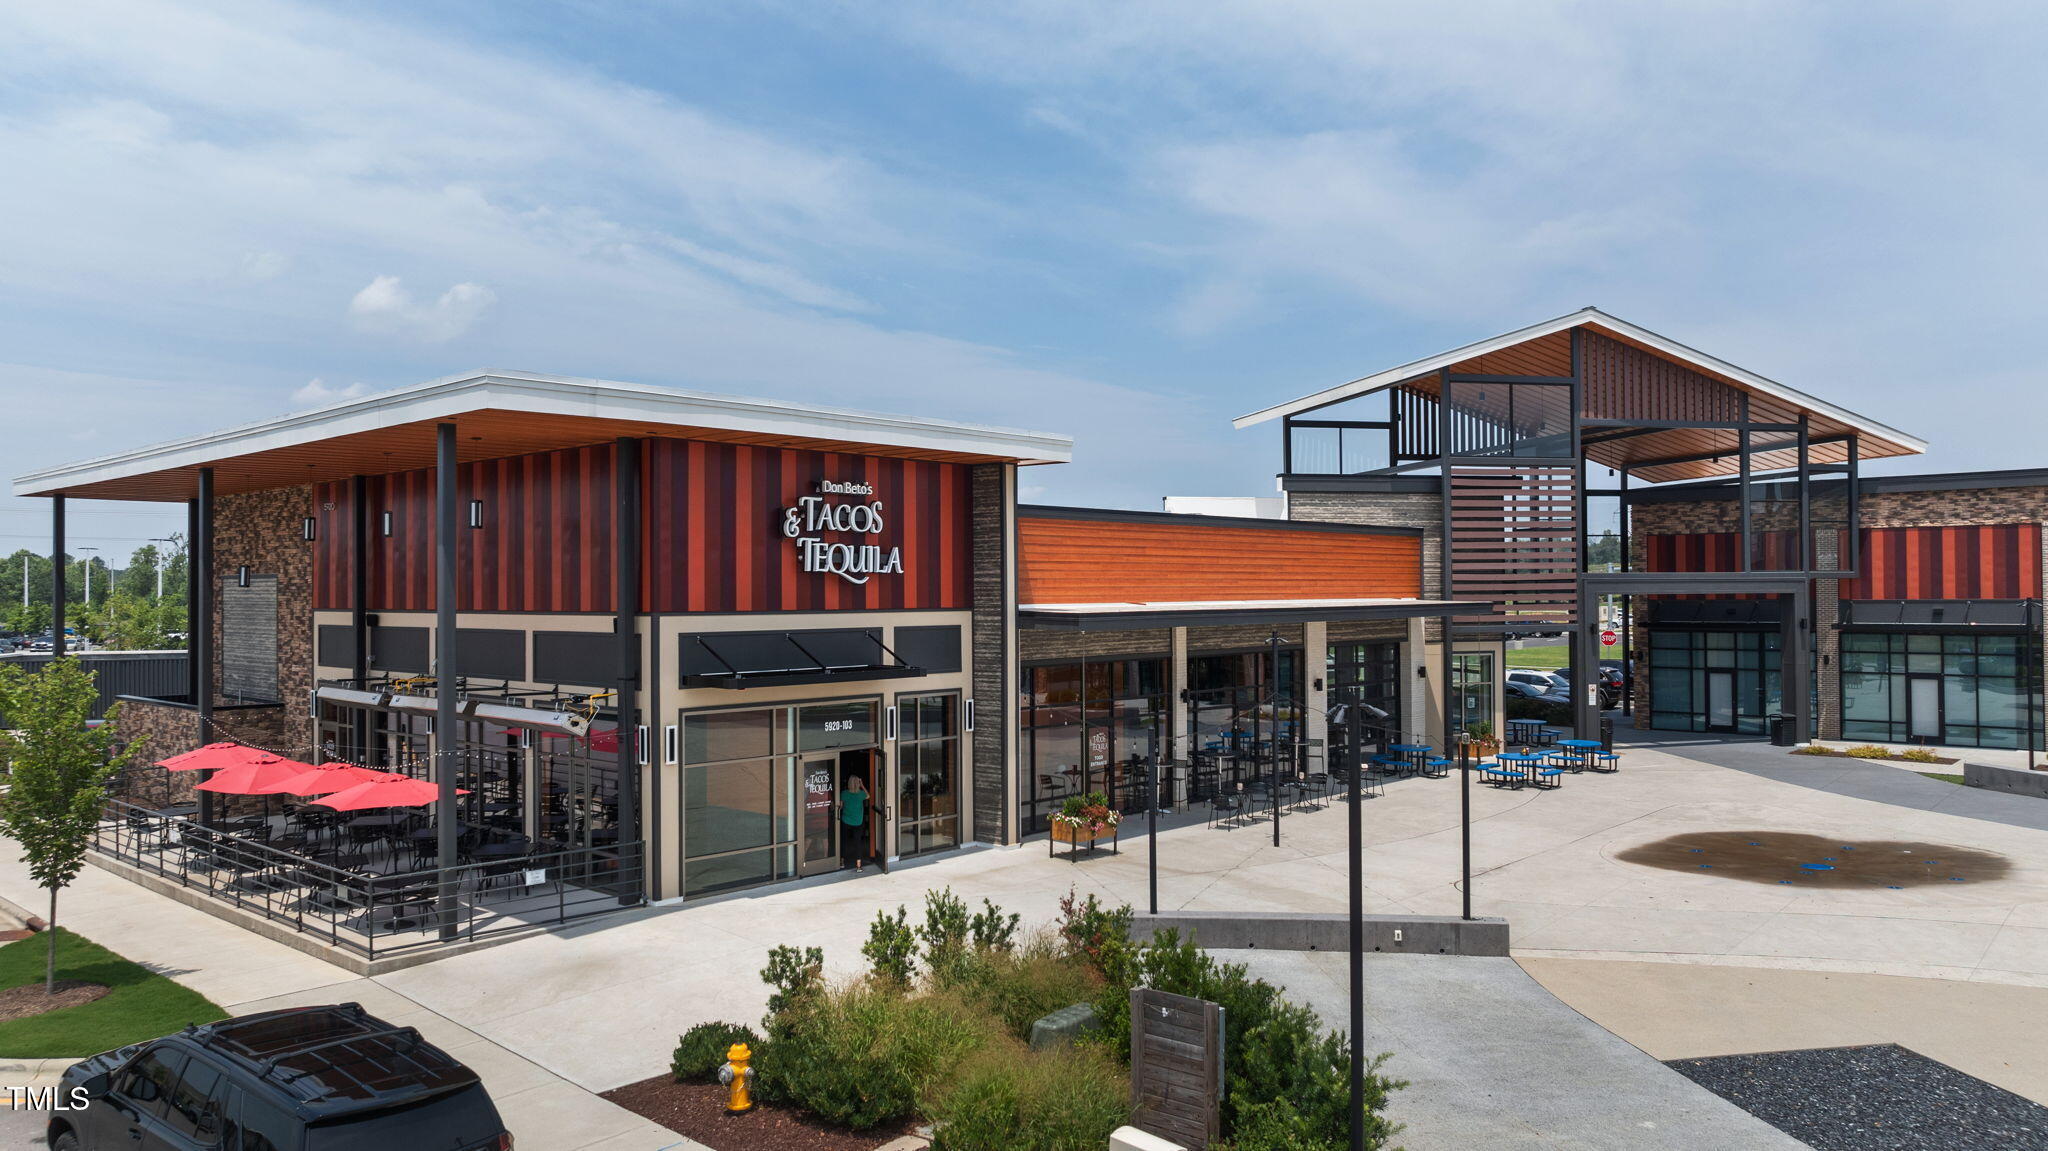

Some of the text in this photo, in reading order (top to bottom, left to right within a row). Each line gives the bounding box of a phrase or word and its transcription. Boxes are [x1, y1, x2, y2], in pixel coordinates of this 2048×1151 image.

[822, 480, 873, 495] Don Beto's
[783, 506, 801, 538] &
[1601, 634, 1616, 642] STOP
[824, 719, 853, 732] 5920-103
[809, 773, 829, 784] TACOS
